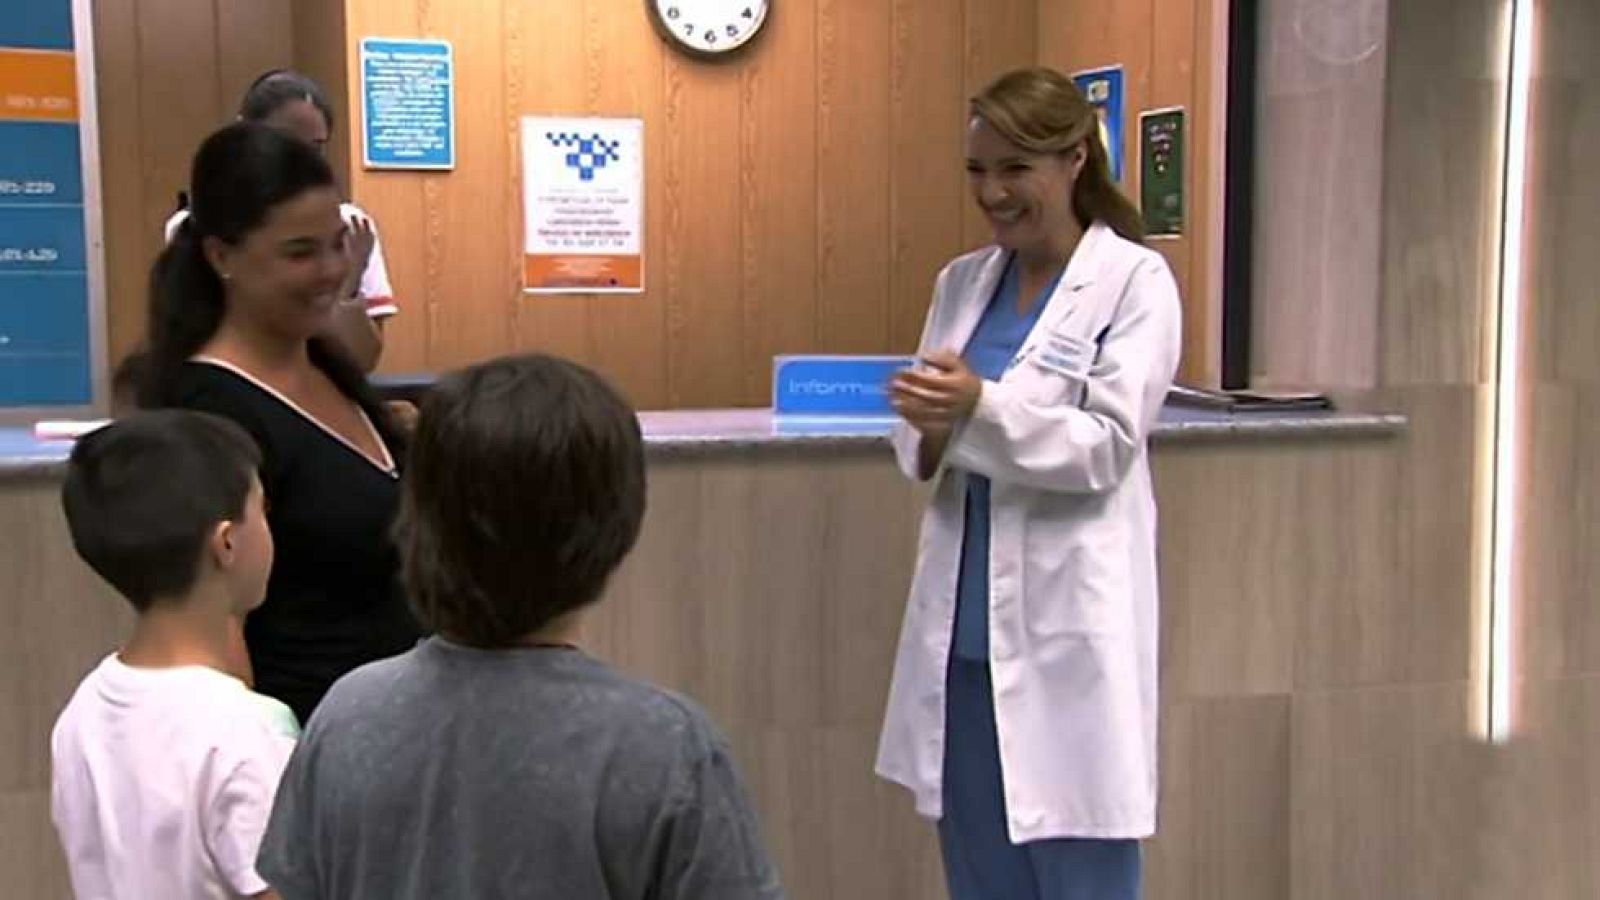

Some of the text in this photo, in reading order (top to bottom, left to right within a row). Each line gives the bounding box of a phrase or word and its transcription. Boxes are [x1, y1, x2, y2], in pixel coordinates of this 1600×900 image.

[740, 7, 752, 19] 4
[683, 23, 694, 36] 7
[725, 23, 739, 37] 5
[704, 29, 717, 44] 6
